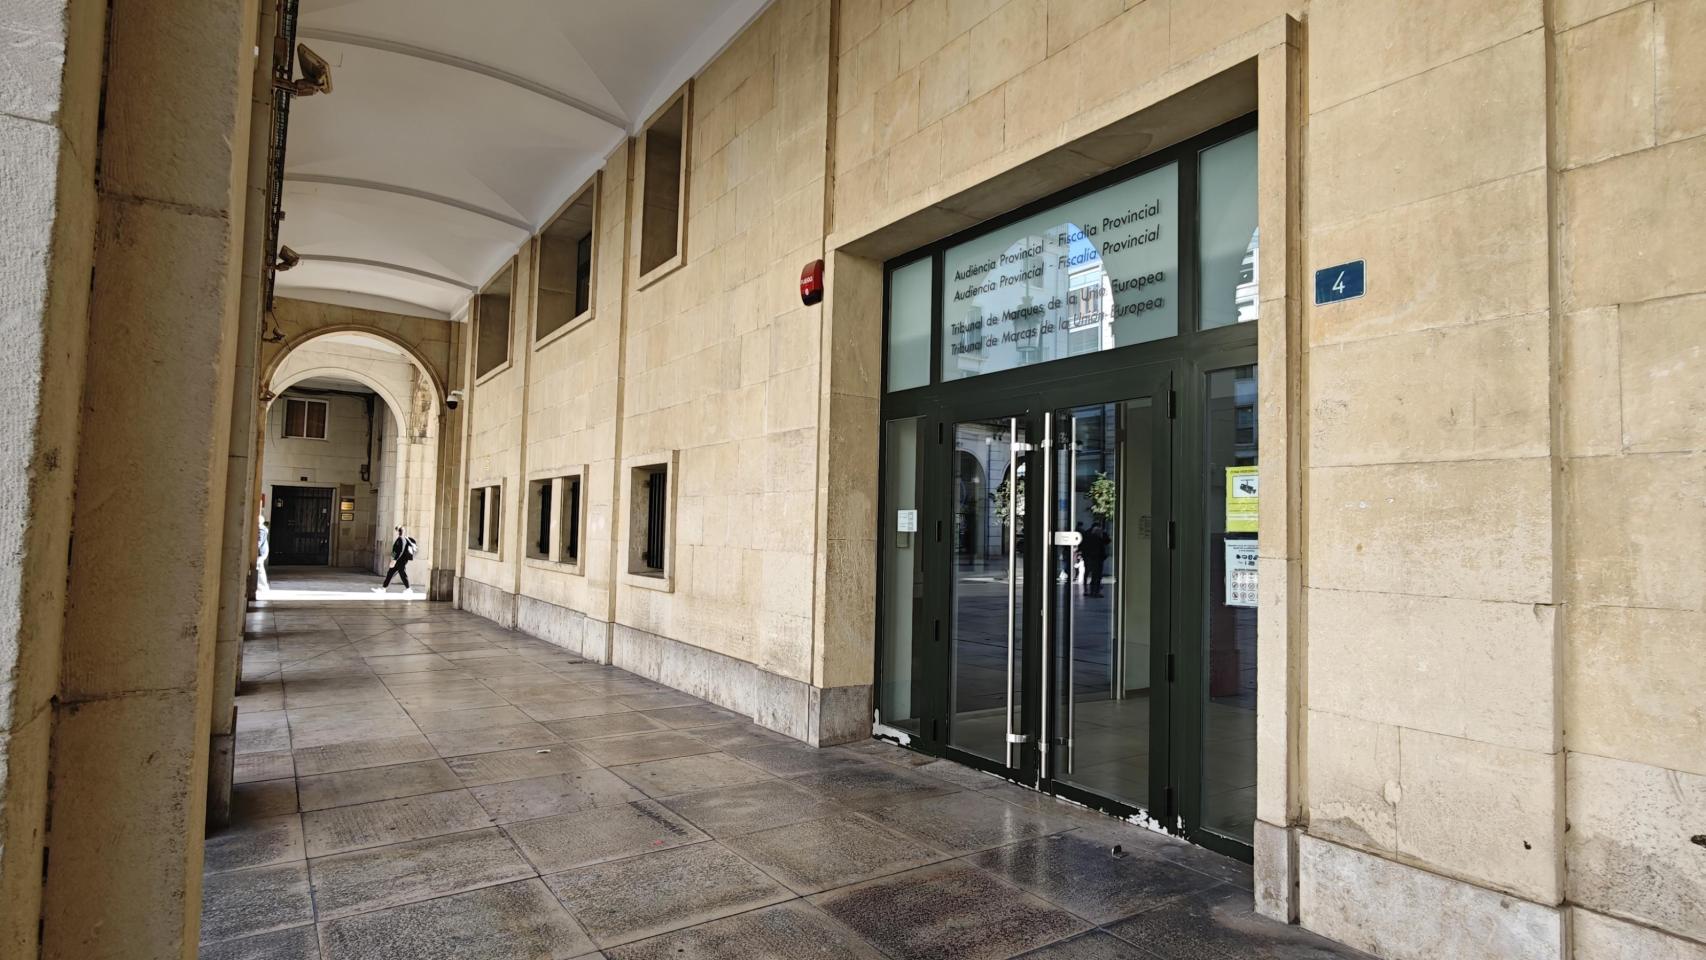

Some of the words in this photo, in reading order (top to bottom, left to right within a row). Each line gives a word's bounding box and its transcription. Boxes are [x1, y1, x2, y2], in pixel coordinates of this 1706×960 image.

[953, 279, 996, 302] Audiencia
[1000, 261, 1044, 288] Provincial
[1102, 224, 1160, 256] Provincial
[1000, 239, 1044, 266] Provincial
[1102, 199, 1160, 232] Provincial
[951, 315, 983, 336] Tribunal
[986, 312, 998, 326] de
[1002, 302, 1044, 323] Marques
[1047, 296, 1062, 310] de
[1066, 291, 1077, 305] la
[1111, 270, 1165, 294] Europea
[1332, 270, 1346, 294] 4
[951, 335, 983, 356] Tribunal
[985, 333, 998, 347] de
[1001, 327, 1037, 344] Marcas
[1040, 319, 1054, 335] de
[1058, 316, 1070, 330] la
[1110, 297, 1164, 320] Europea
